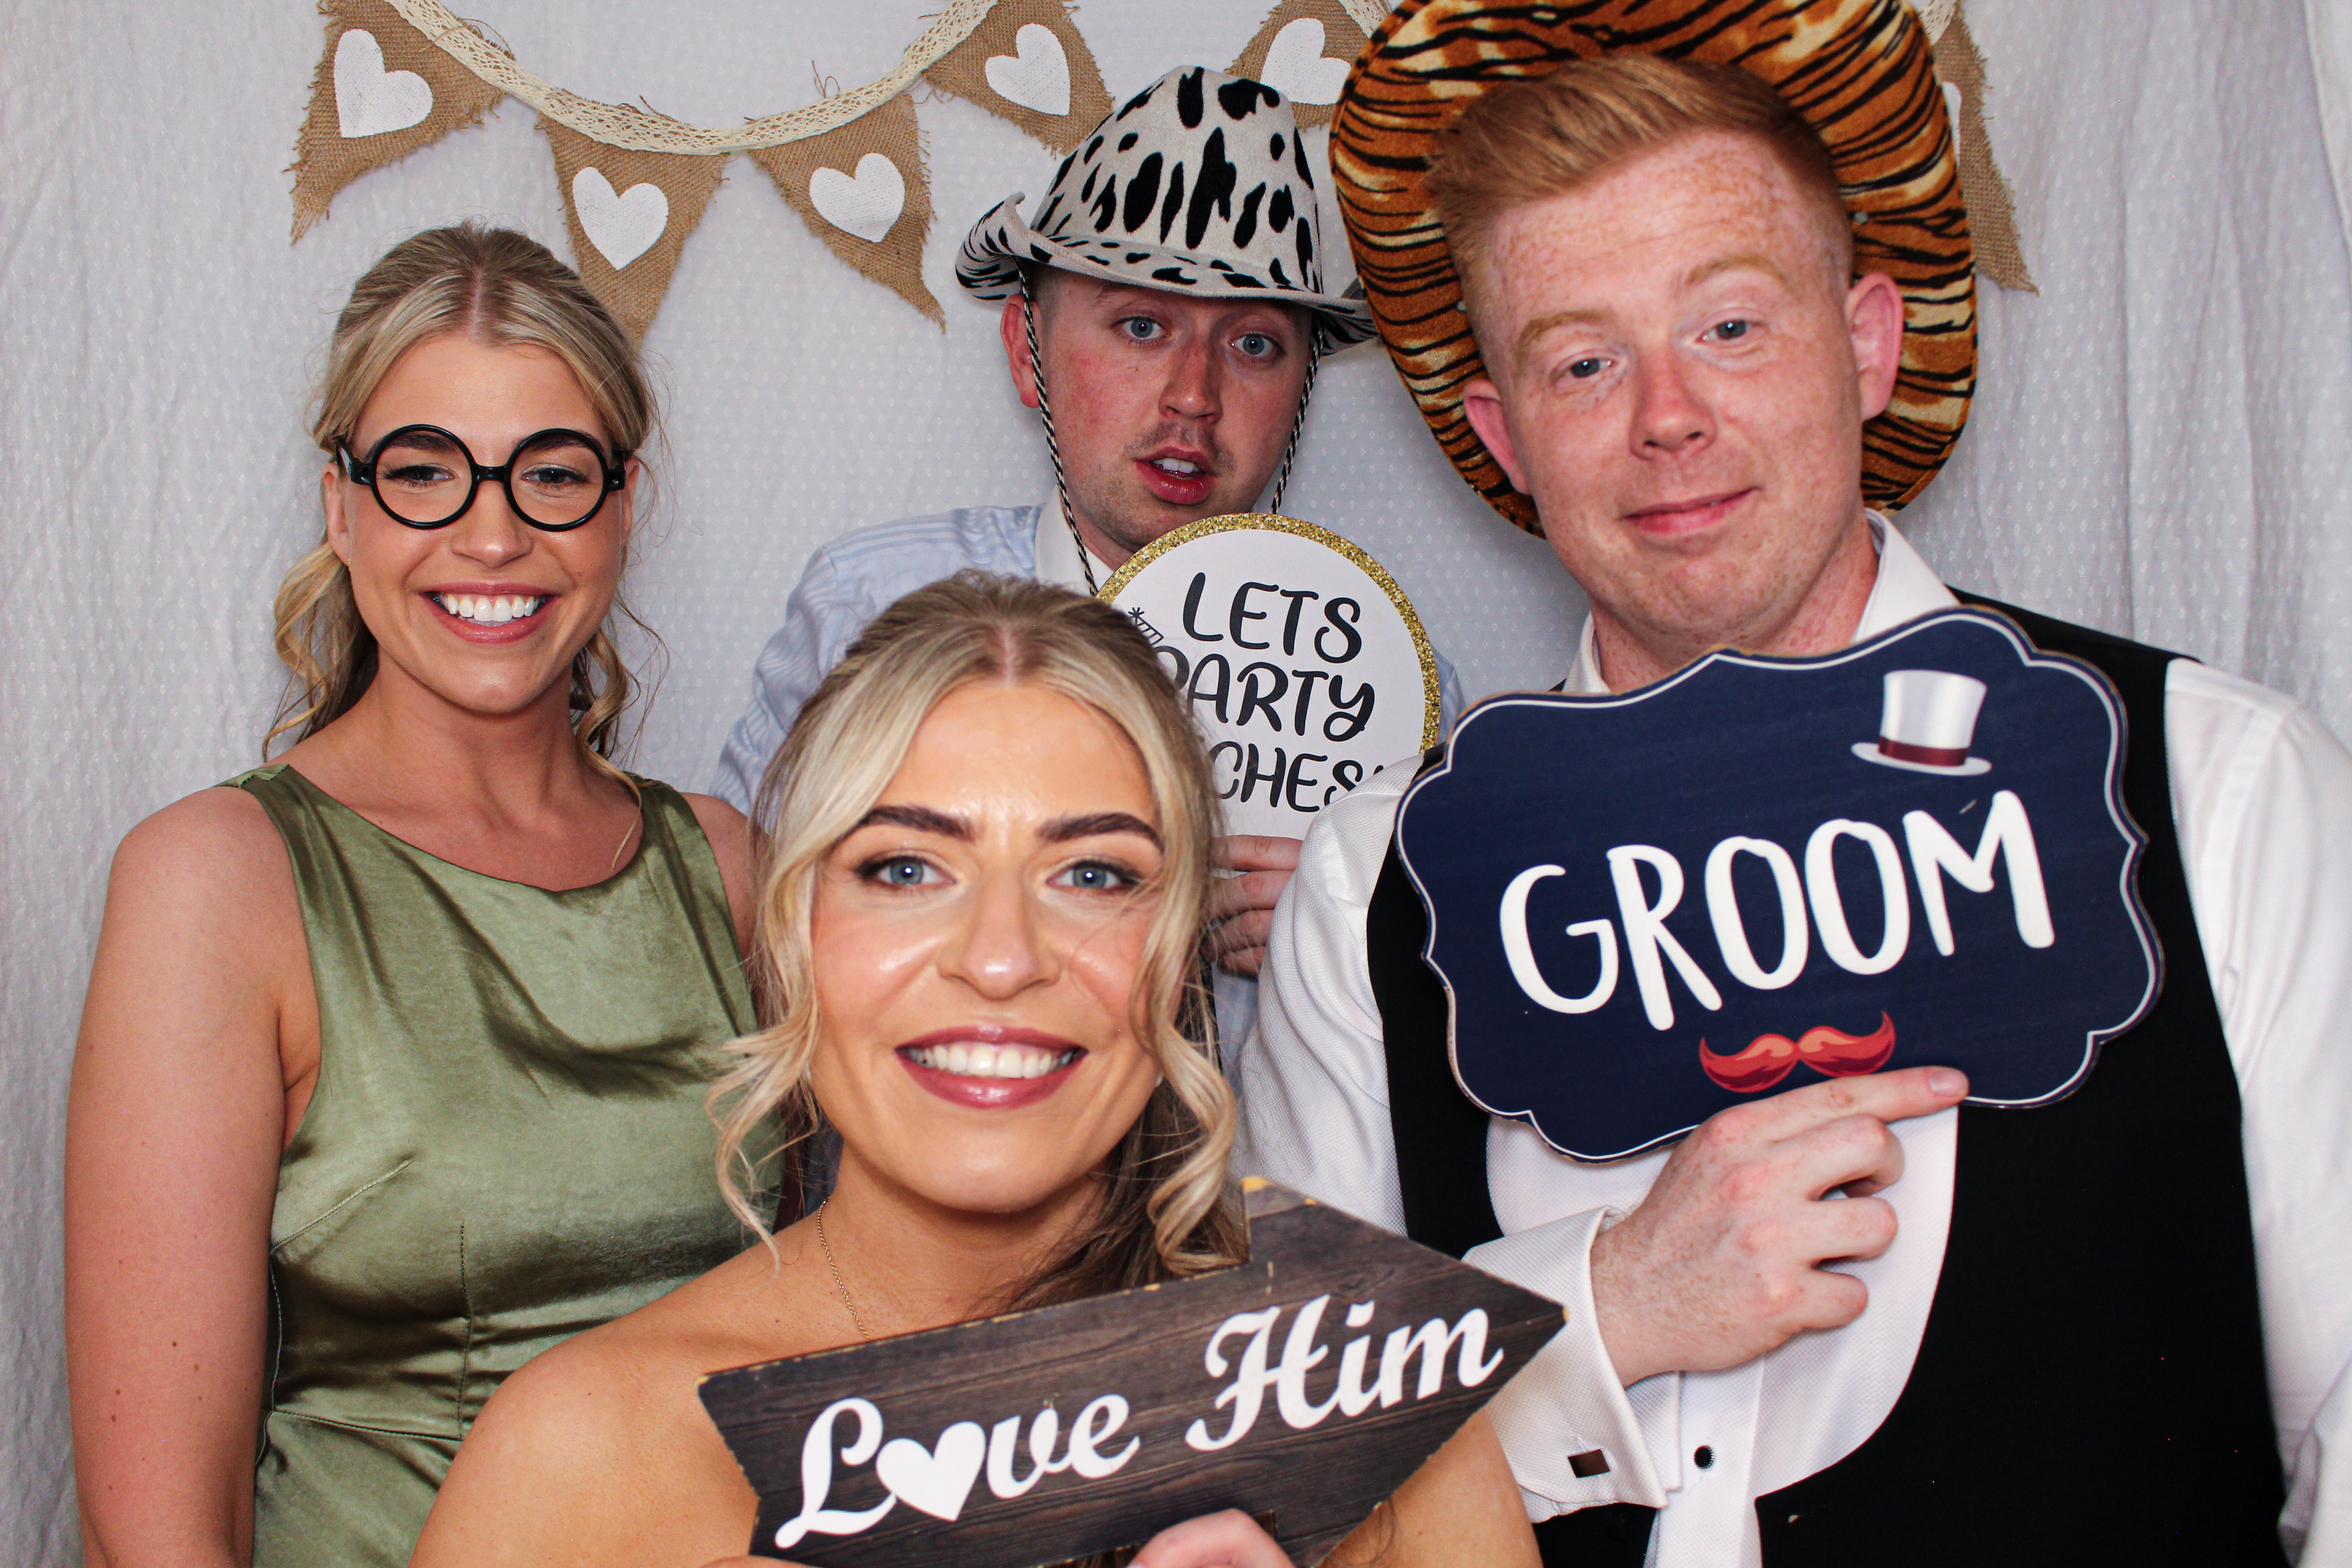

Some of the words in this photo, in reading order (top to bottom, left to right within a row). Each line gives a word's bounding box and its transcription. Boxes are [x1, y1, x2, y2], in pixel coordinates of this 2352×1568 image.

[1182, 572, 1362, 664] LETS
[1499, 790, 2055, 1031] GROOM
[1185, 1294, 1504, 1451] Him
